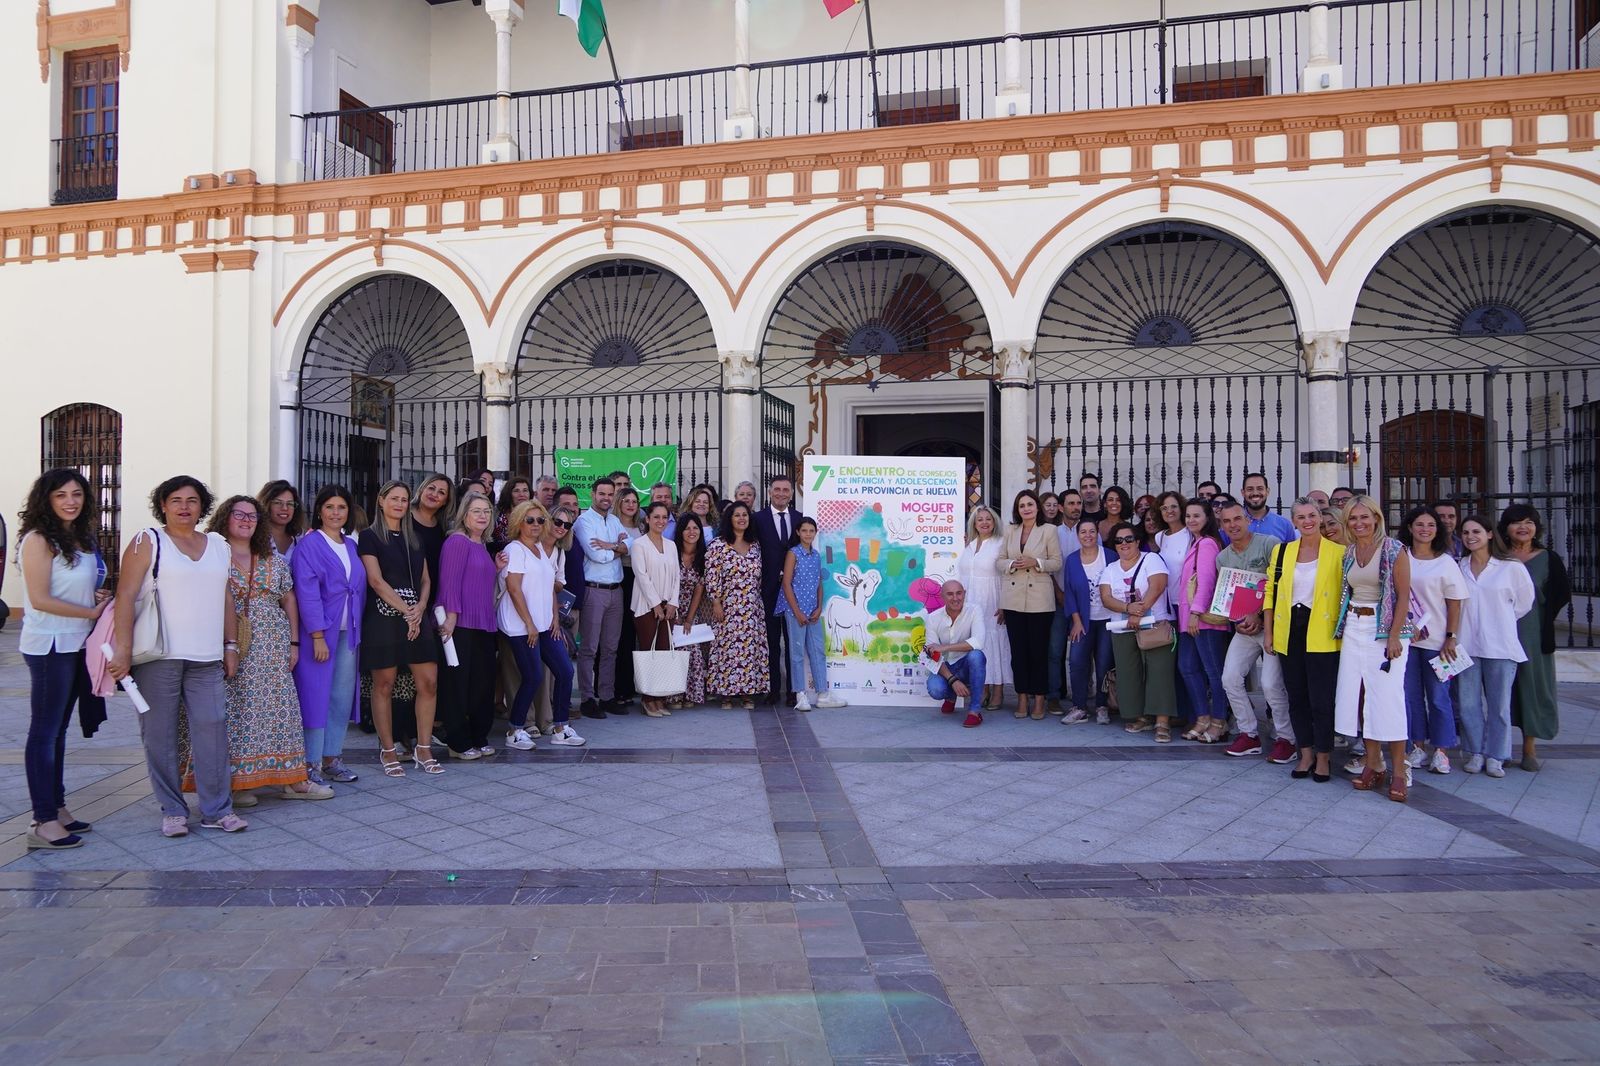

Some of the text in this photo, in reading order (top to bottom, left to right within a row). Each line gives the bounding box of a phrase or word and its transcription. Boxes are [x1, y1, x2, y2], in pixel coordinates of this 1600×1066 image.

[839, 466, 905, 476] ENCUENTRO
[895, 478, 958, 486] ADOLESCENCIA
[861, 486, 910, 495] PROVINCIA
[901, 502, 954, 513] MOGUER
[922, 536, 953, 544] 2023
